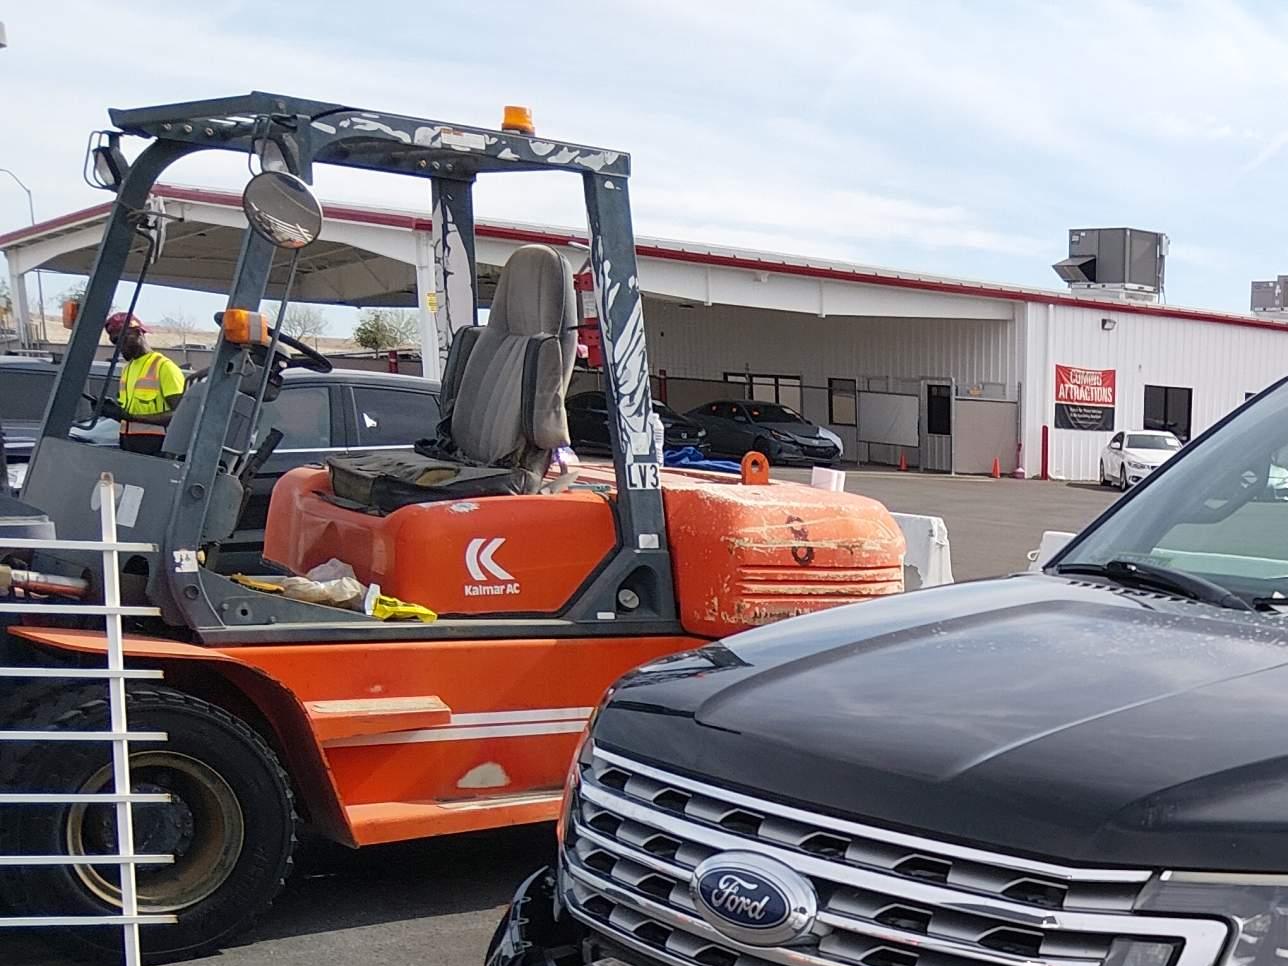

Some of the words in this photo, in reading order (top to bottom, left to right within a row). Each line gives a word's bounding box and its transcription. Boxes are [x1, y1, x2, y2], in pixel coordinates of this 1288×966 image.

[1069, 369, 1103, 387] COMING
[1058, 383, 1113, 403] ATTRACTIONS
[627, 464, 659, 488] LV3
[464, 584, 505, 596] Kalmar
[506, 583, 520, 594] AC
[711, 874, 770, 920] Ford
